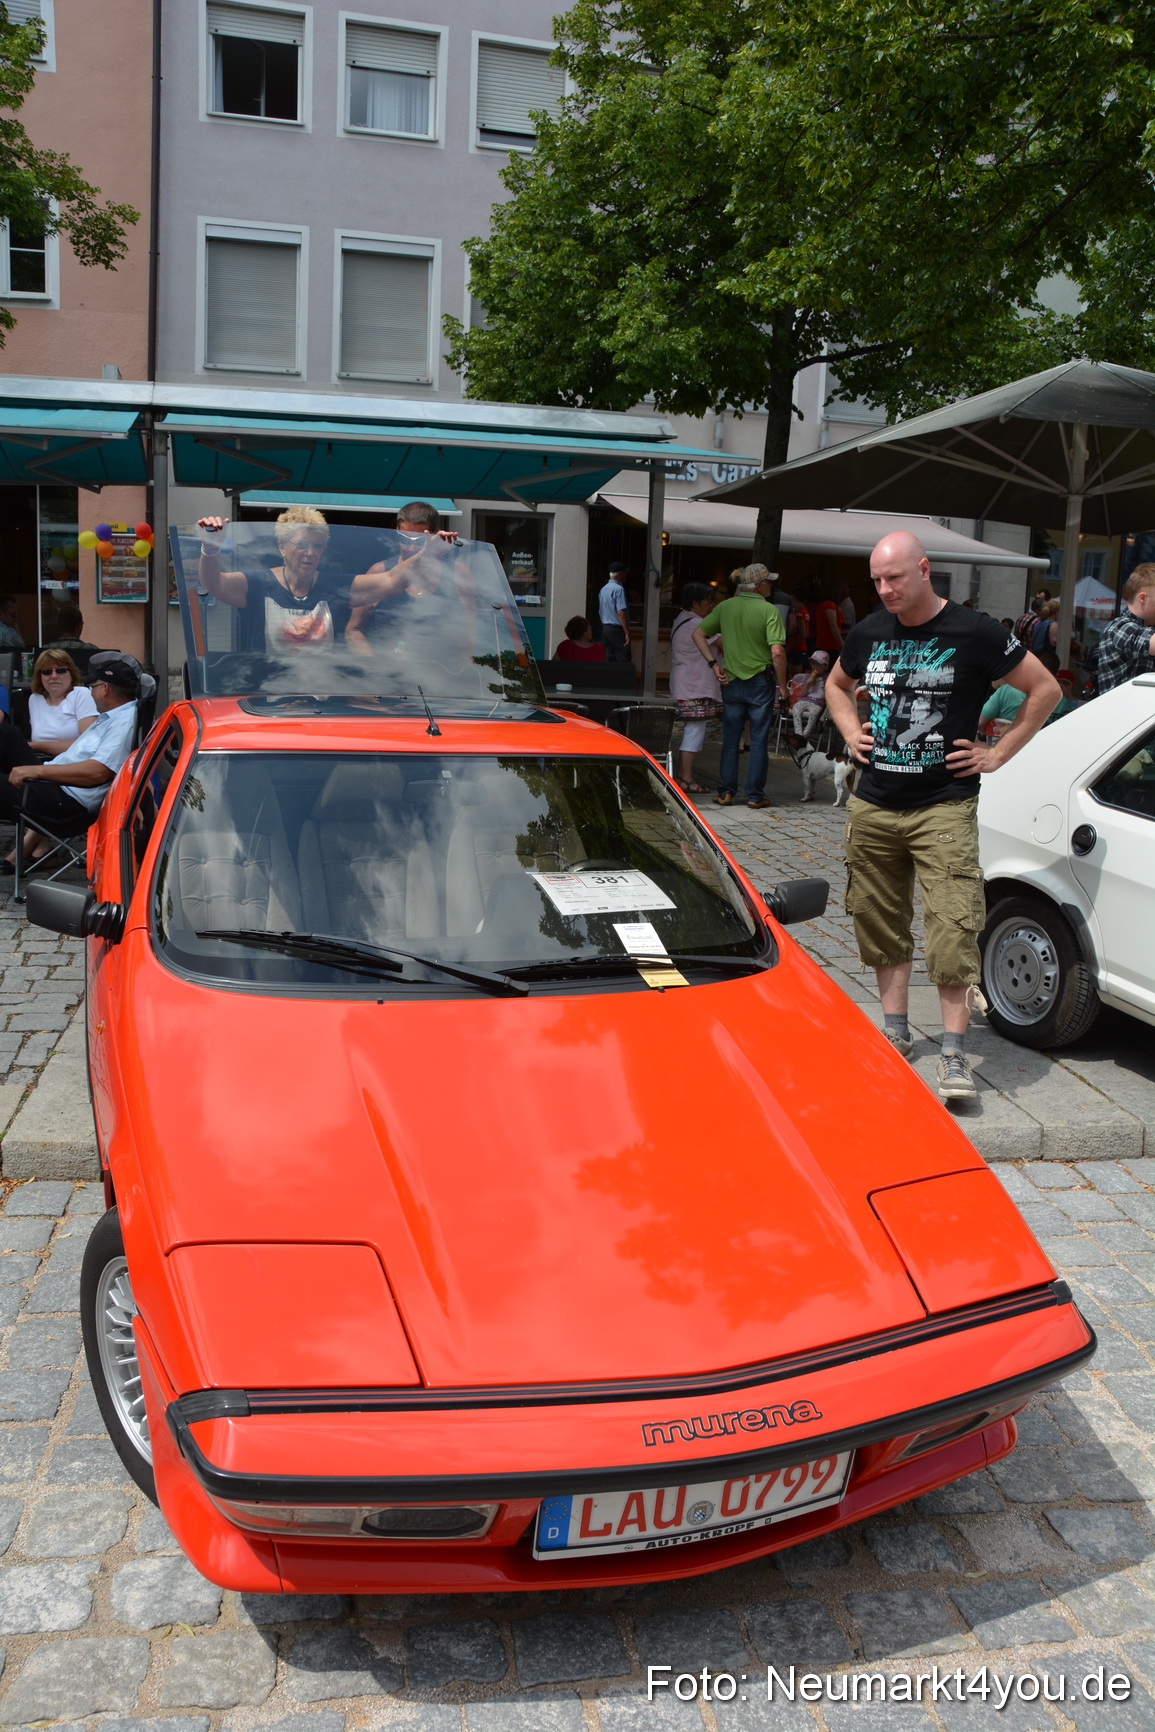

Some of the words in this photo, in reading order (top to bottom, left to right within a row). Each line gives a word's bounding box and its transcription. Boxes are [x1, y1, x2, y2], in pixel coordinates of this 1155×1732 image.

[511, 551, 534, 559] Außen-
[898, 742, 920, 750] BLACK
[924, 741, 945, 750] SLOPE
[901, 751, 916, 760] ICE
[921, 750, 945, 759] PARTY
[591, 875, 629, 884] 381
[641, 1399, 823, 1447] murena
[547, 1526, 559, 1540] D
[579, 1485, 687, 1539] LAU
[719, 1453, 838, 1518] 0799
[645, 1521, 755, 1550] AUTO-KROPF
